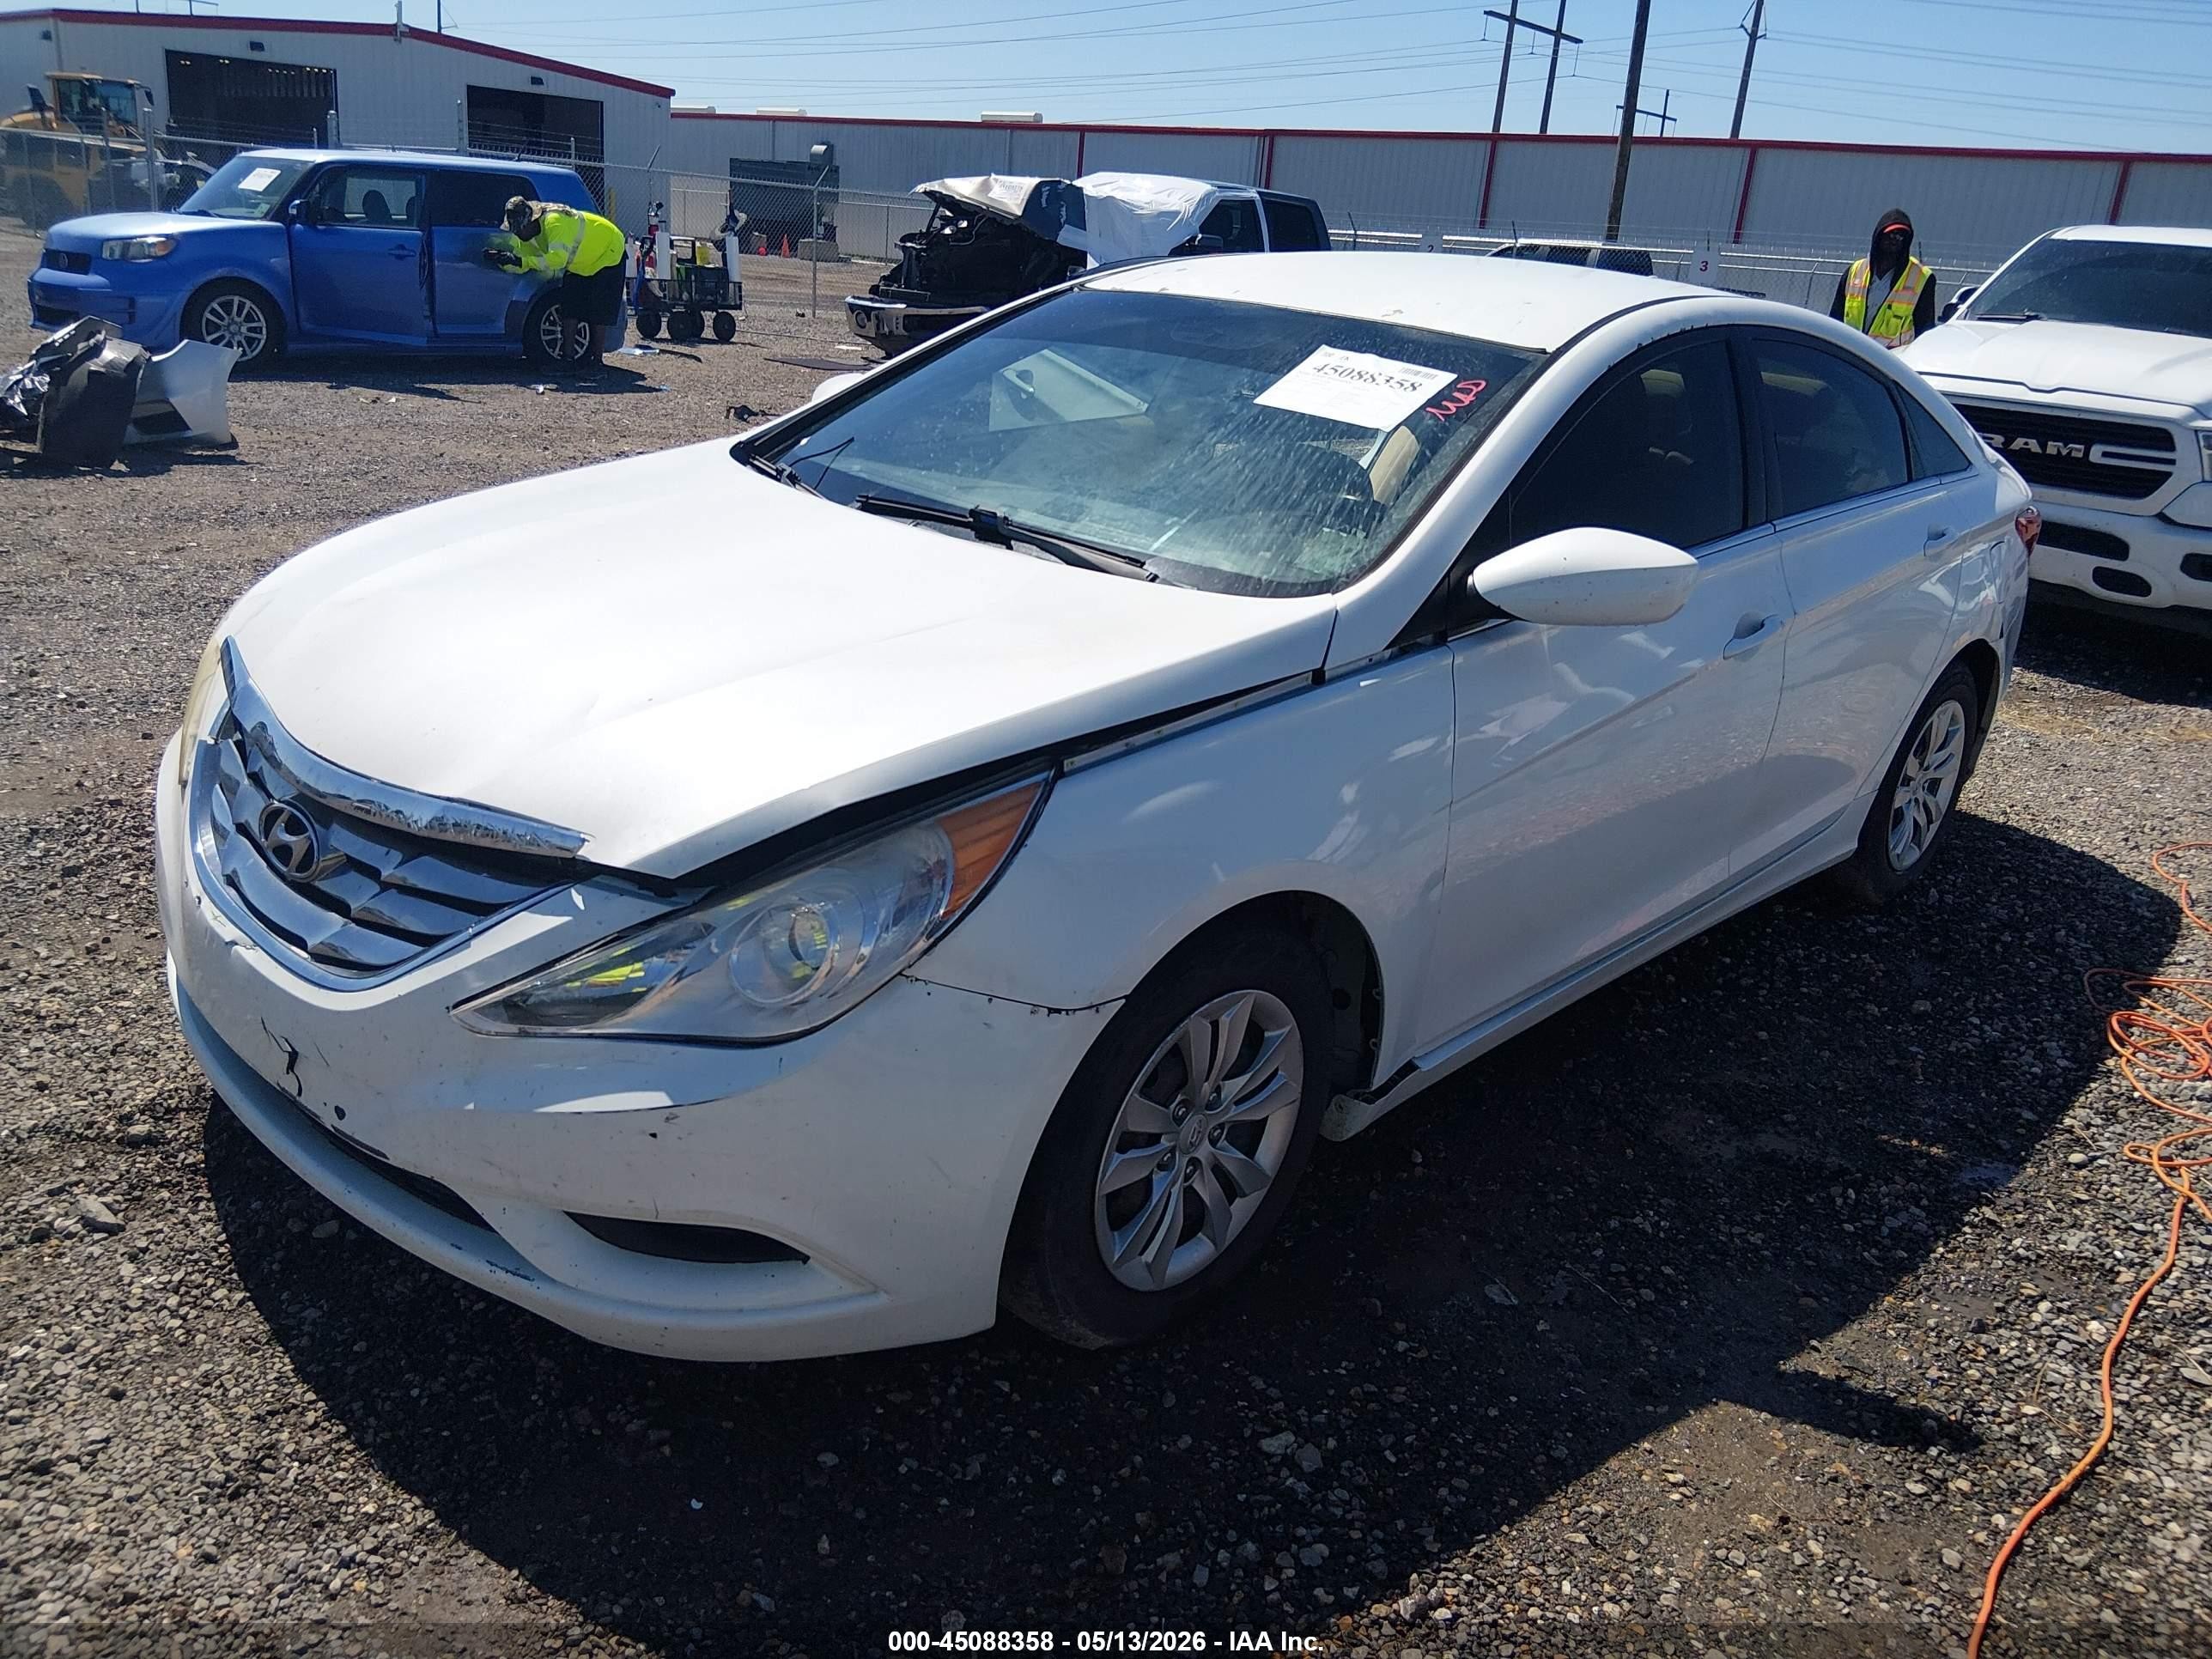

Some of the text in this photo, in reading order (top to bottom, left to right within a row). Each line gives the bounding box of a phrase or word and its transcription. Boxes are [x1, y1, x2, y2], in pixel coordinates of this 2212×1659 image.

[1699, 260, 1709, 272] 3
[1312, 363, 1423, 392] 45088358
[1978, 432, 2085, 459] RAM
